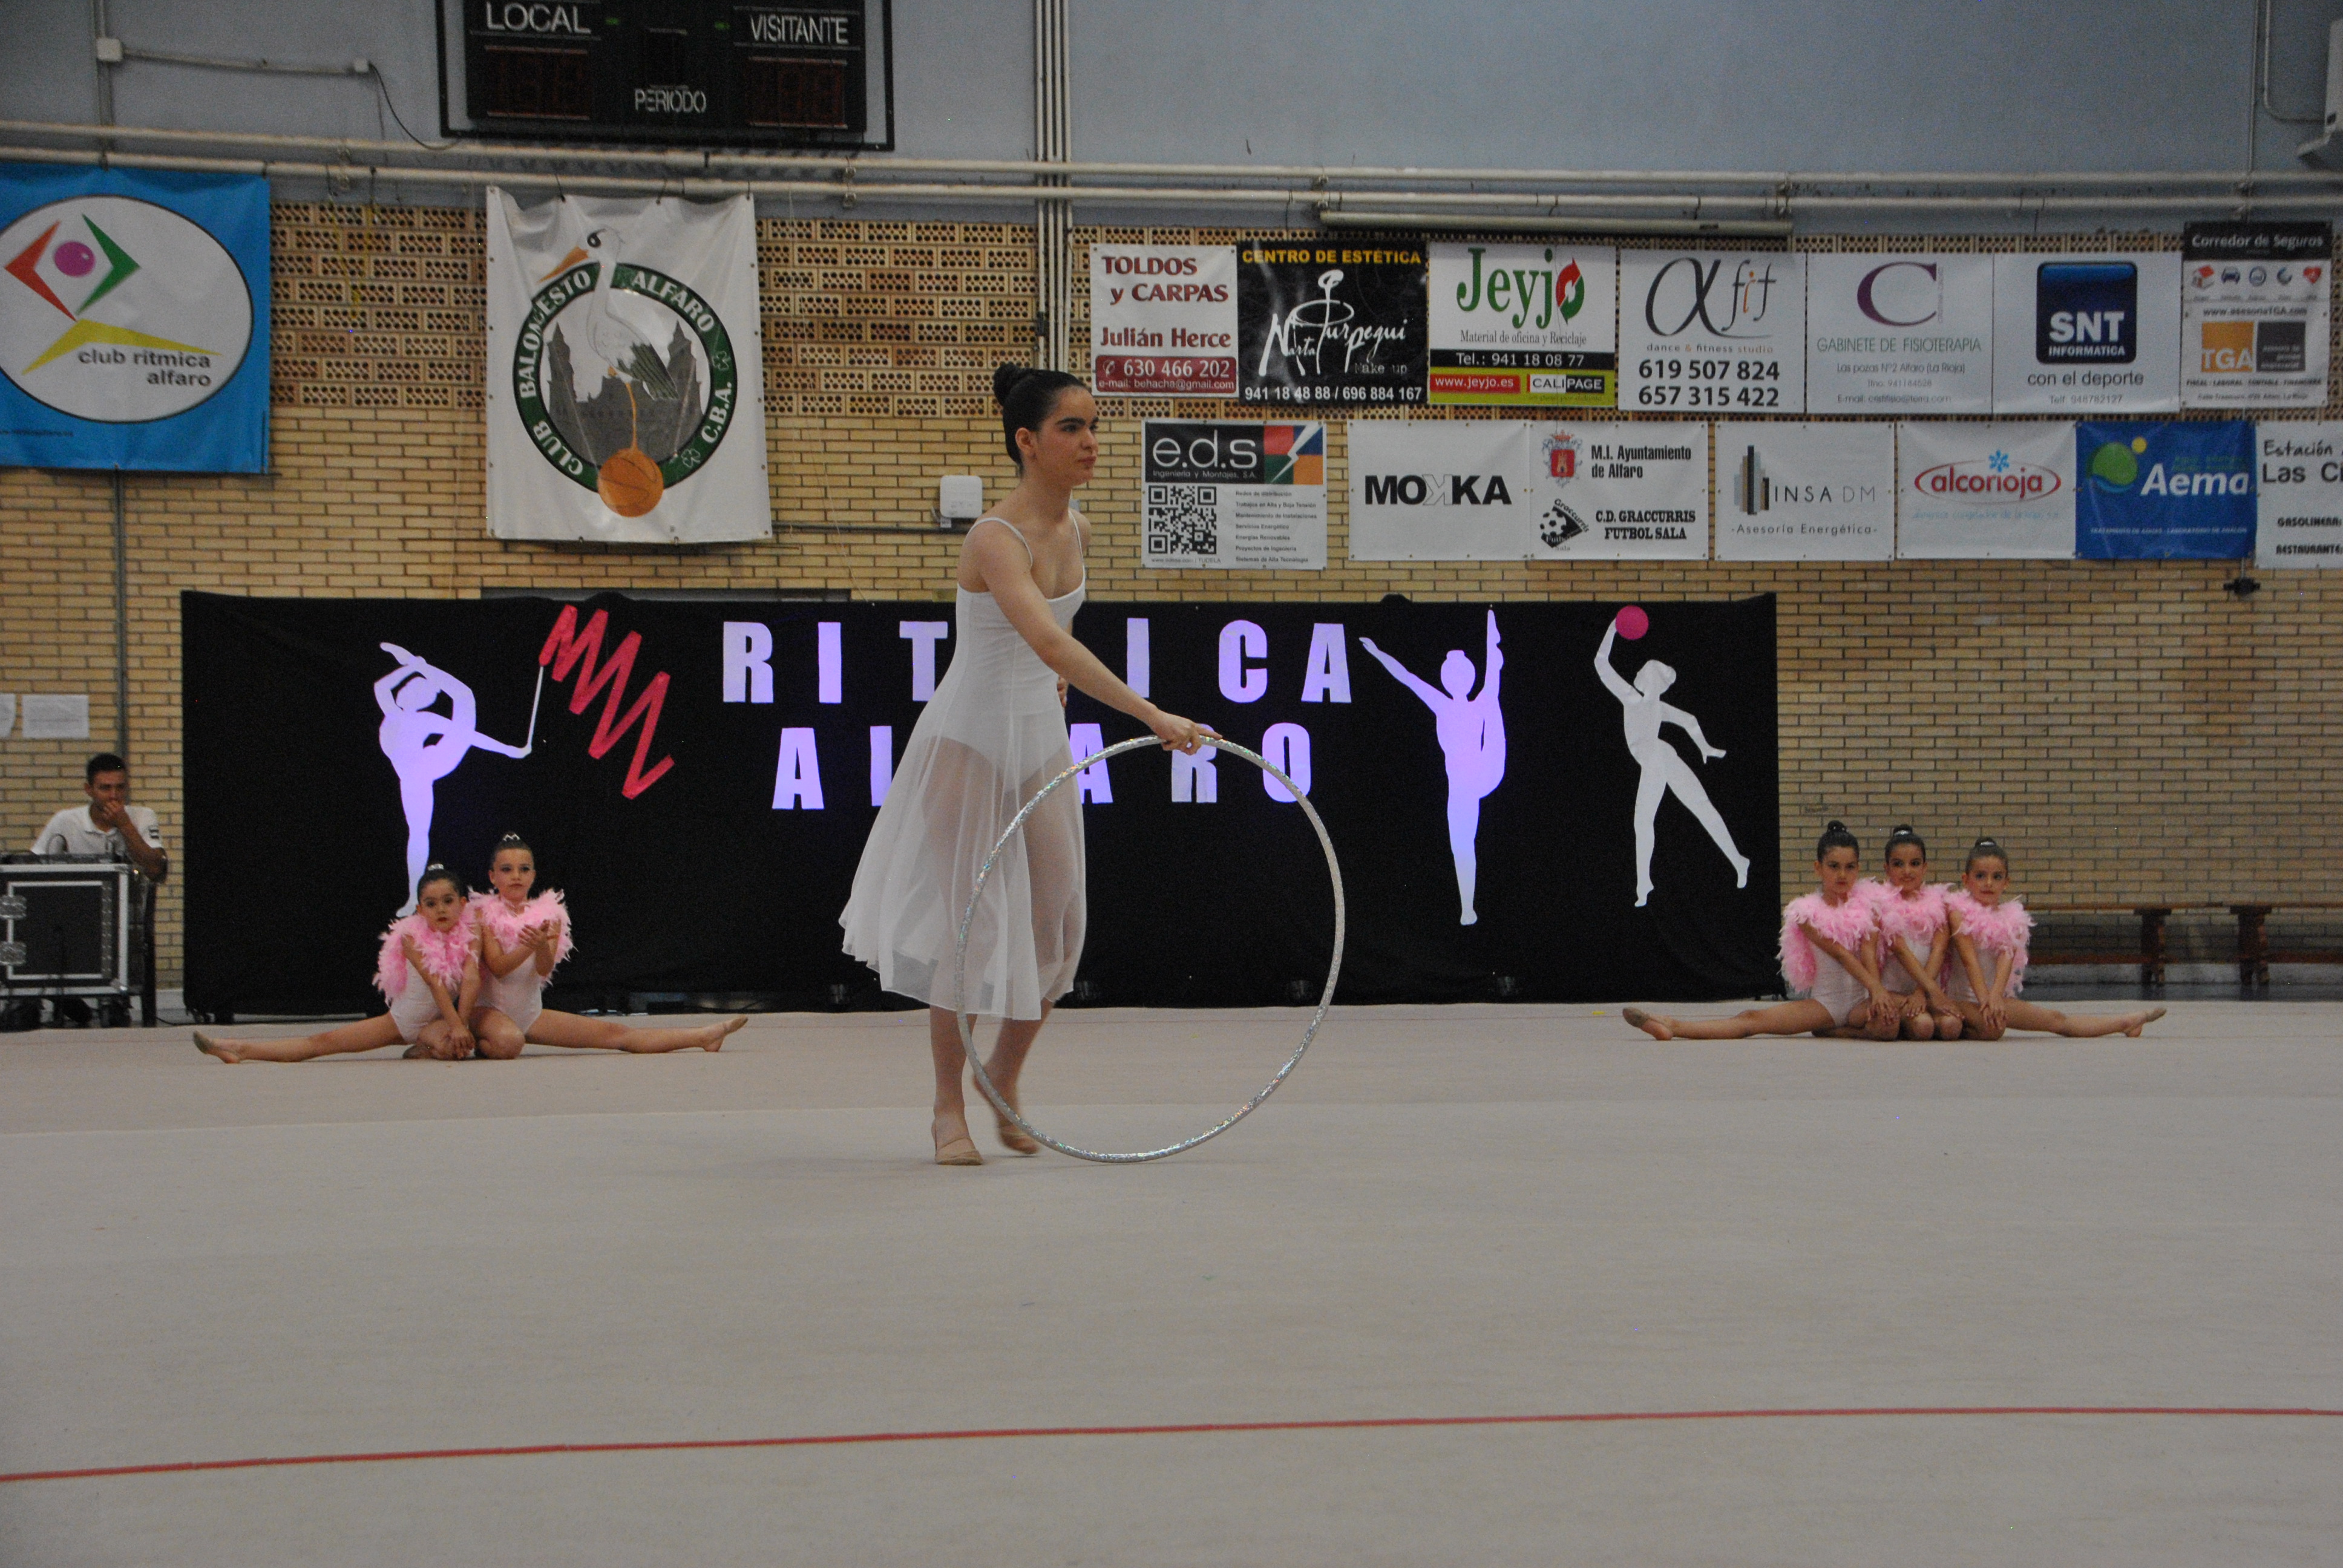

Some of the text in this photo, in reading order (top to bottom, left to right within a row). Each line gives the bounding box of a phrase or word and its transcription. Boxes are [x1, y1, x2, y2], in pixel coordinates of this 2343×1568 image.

[487, 1, 591, 34] LOCAL
[750, 15, 848, 44] VISITANTE
[634, 88, 707, 113] PERIODO
[2191, 234, 2324, 251] Corredor de Seguros
[1242, 247, 1421, 264] CENTRO DE ESTÉTICA
[1101, 255, 1198, 276] TOLDOS
[1110, 283, 1229, 305] y CARPAS
[1100, 326, 1231, 347] Julián Herce
[2050, 311, 2125, 343] SNT
[1460, 330, 1587, 347] Material de oficina y Reciclaje
[1817, 337, 1982, 353] GABINETE DE FISIOTERAPIA
[78, 348, 126, 364] club
[1647, 343, 1680, 352] dance
[1696, 344, 1733, 353] fitness
[1737, 345, 1774, 354] studio
[2048, 345, 2126, 356] INFORMATICA
[1456, 352, 1585, 367] Tel.: 941 18 08 77
[2201, 347, 2255, 370] TGA
[146, 368, 211, 387] alfaro
[533, 420, 583, 475] CLUB
[631, 270, 715, 332] ALFARO
[1124, 359, 1230, 378] 630 466 202
[1639, 359, 1780, 381] 619 507 824
[1435, 376, 1514, 390] www.jeyjo.es
[2027, 370, 2144, 388] con el deporte
[1245, 387, 1268, 400] 941
[1274, 387, 1290, 400] 18
[1294, 387, 1311, 400] 48
[1314, 387, 1331, 400] 88
[1342, 387, 1366, 400] 696
[1370, 387, 1394, 400] 884
[1398, 387, 1422, 400] 167
[1638, 385, 1780, 407] 657 315 422
[701, 382, 732, 443] C.B.A.
[1617, 445, 1692, 463] Ayuntamiento
[2263, 439, 2333, 457] Estación
[1591, 463, 1643, 479] de Alfaro
[2140, 463, 2250, 497] Aema
[2263, 463, 2306, 483] Las
[1931, 465, 2043, 500] alcorioja
[1595, 510, 1696, 523] C.D. GRACCURRIS
[1604, 527, 1687, 540] FUTBOL SALA
[723, 617, 1352, 704] RITICA
